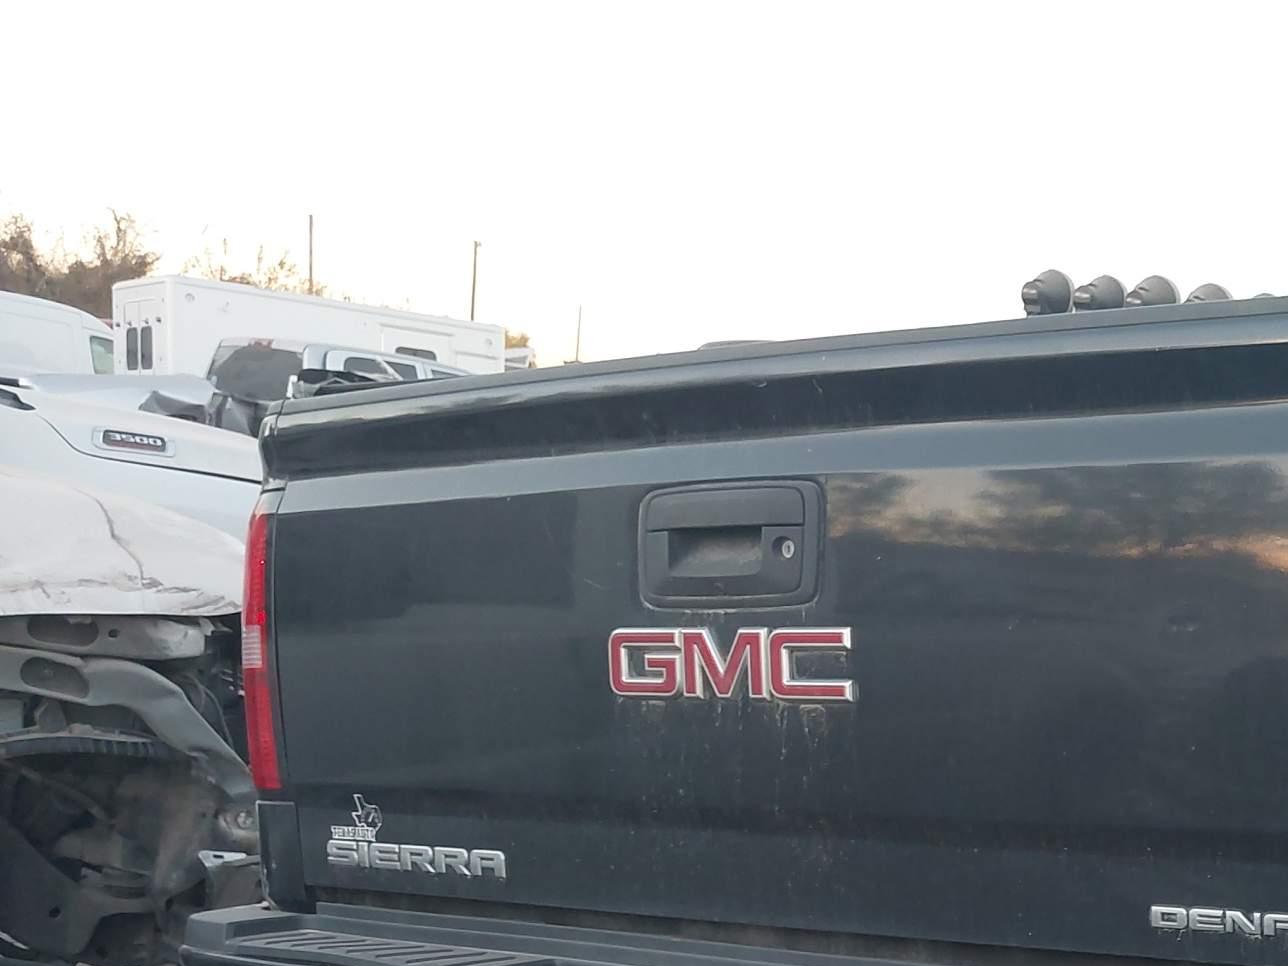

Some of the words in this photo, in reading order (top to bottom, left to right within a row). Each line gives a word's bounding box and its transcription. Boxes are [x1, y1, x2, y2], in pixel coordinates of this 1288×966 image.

[108, 431, 162, 446] 3500
[609, 627, 855, 702] GMC
[327, 839, 507, 879] SIERRA
